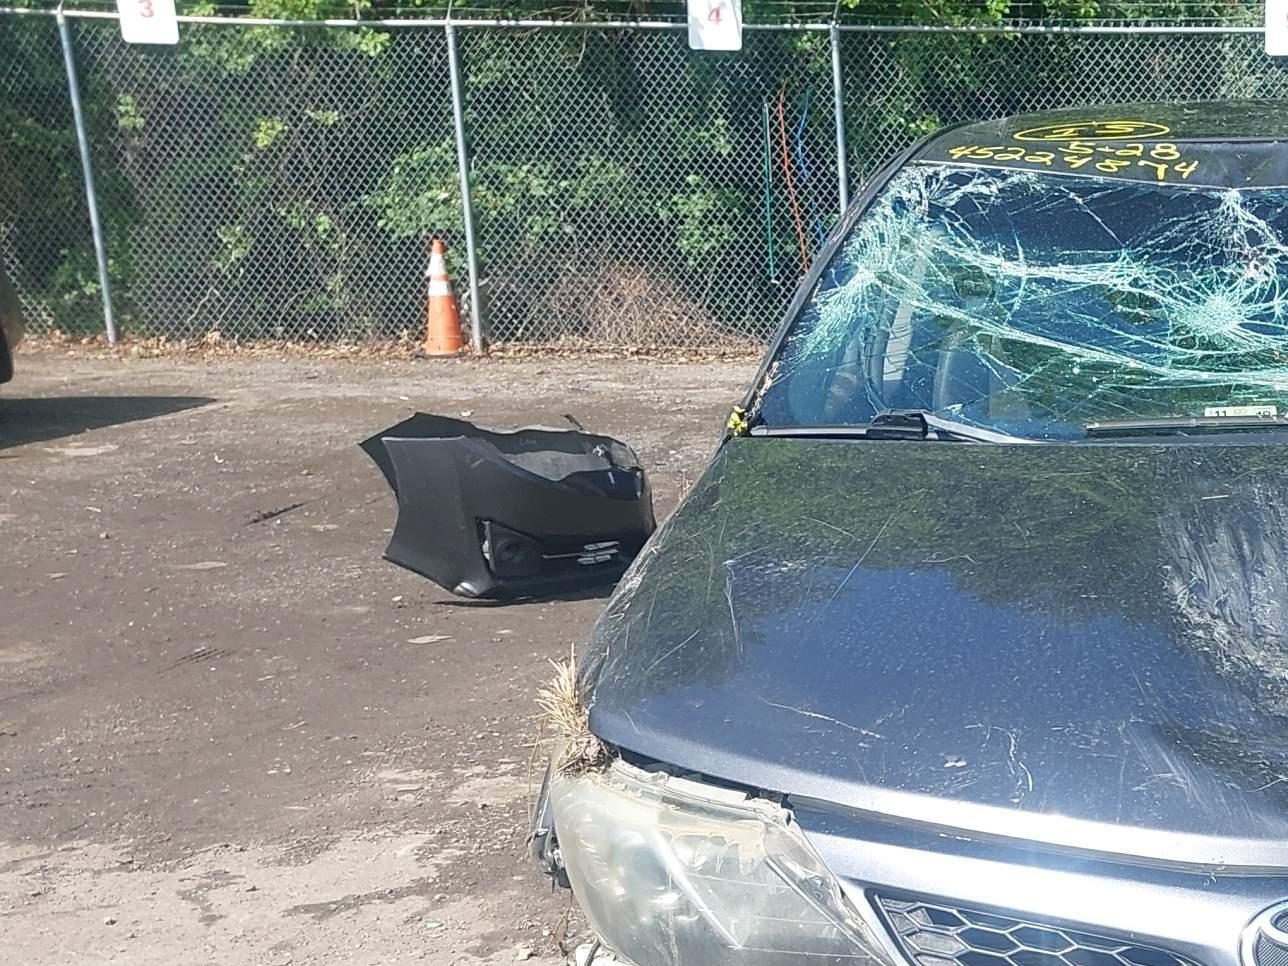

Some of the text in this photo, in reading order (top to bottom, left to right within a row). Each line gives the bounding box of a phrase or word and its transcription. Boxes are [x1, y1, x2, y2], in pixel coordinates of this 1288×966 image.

[140, 0, 154, 18] 3
[707, 6, 722, 25] 4
[949, 145, 1200, 182] 45224874
